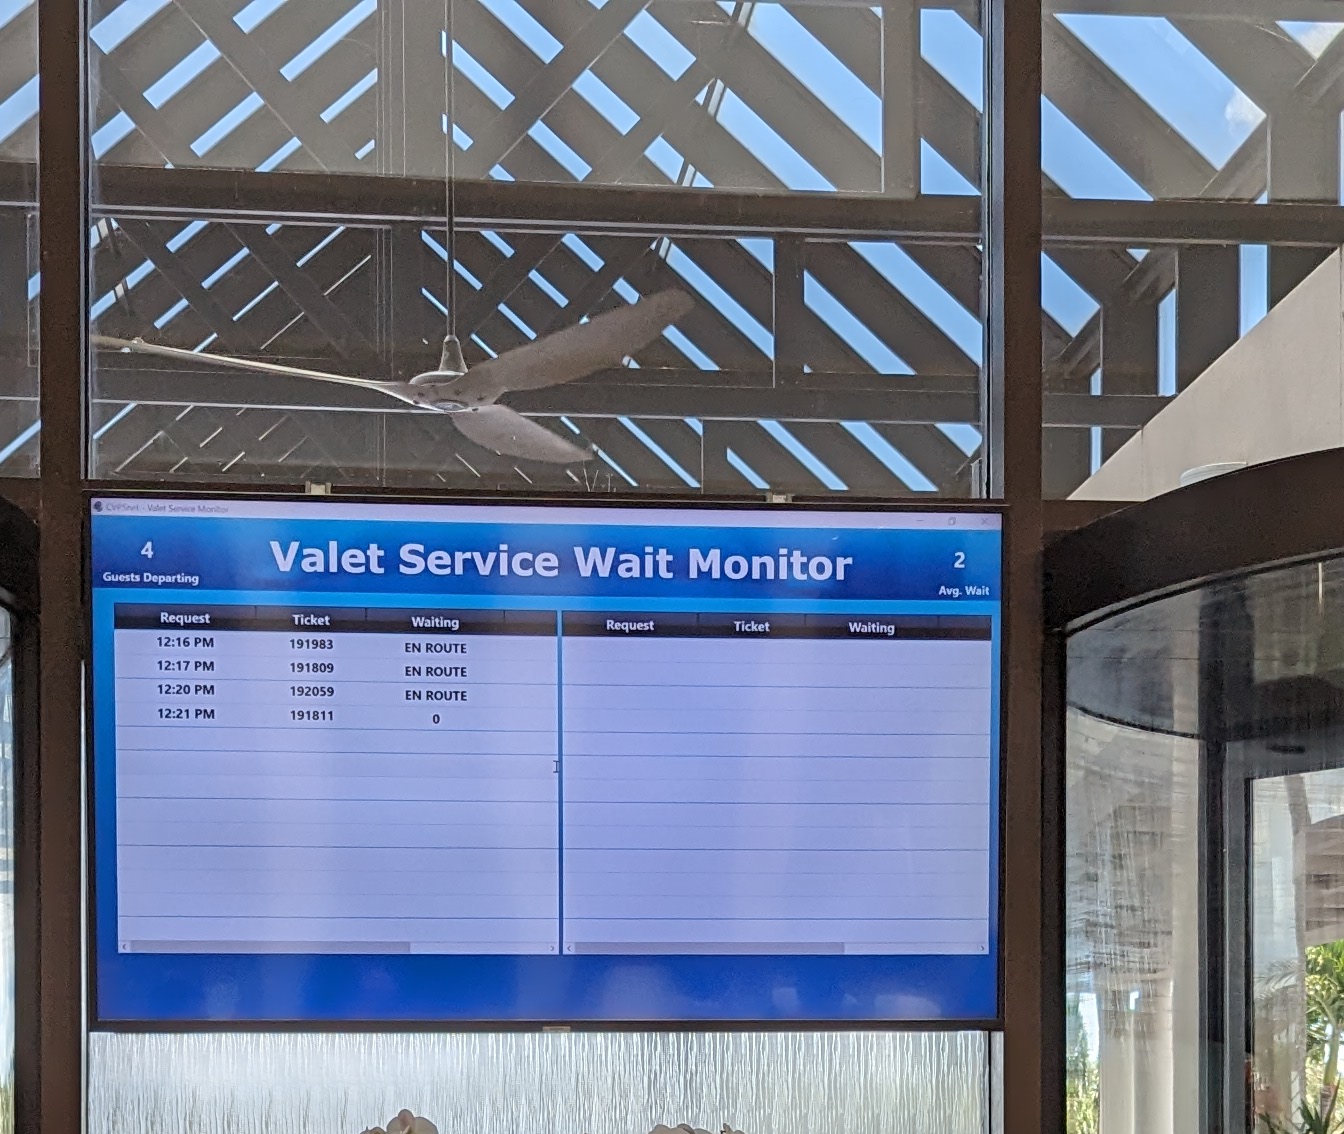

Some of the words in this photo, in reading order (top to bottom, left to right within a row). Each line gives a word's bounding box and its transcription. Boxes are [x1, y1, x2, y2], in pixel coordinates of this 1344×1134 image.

[147, 503, 166, 512] Valet
[168, 504, 196, 513] Service
[197, 504, 229, 514] Monitor
[140, 541, 154, 559] 4
[269, 540, 385, 574] Valet
[399, 543, 559, 578] Service
[573, 545, 674, 579] Wait
[688, 547, 853, 581] Monitor
[953, 551, 966, 569] 2
[102, 571, 141, 582] Guests
[143, 572, 200, 587] Departing
[938, 585, 963, 598] Avg.
[964, 585, 990, 596] Wait
[160, 611, 211, 627] Request
[291, 613, 331, 626] Ticket
[410, 615, 460, 631] Waiting
[606, 619, 655, 634] Request
[733, 620, 771, 632] Ticket
[848, 621, 895, 636] Waiting
[156, 636, 191, 648] 12:16
[194, 636, 214, 648] PM
[289, 638, 334, 650] 191983
[404, 642, 422, 654] EN
[425, 642, 467, 654] ROUTE
[157, 660, 191, 672] 12:17
[194, 660, 215, 672] PM
[290, 662, 334, 674] 191809
[405, 665, 422, 677] EN
[425, 666, 468, 678] ROUTE
[157, 683, 191, 695] 12:20
[194, 684, 215, 696] PM
[290, 685, 335, 697] 192059
[405, 689, 422, 701] EN
[425, 690, 468, 702] ROUTE
[157, 708, 190, 720] 12:21
[194, 708, 215, 720] PM
[290, 710, 334, 721] 191811
[432, 713, 441, 725] 0
